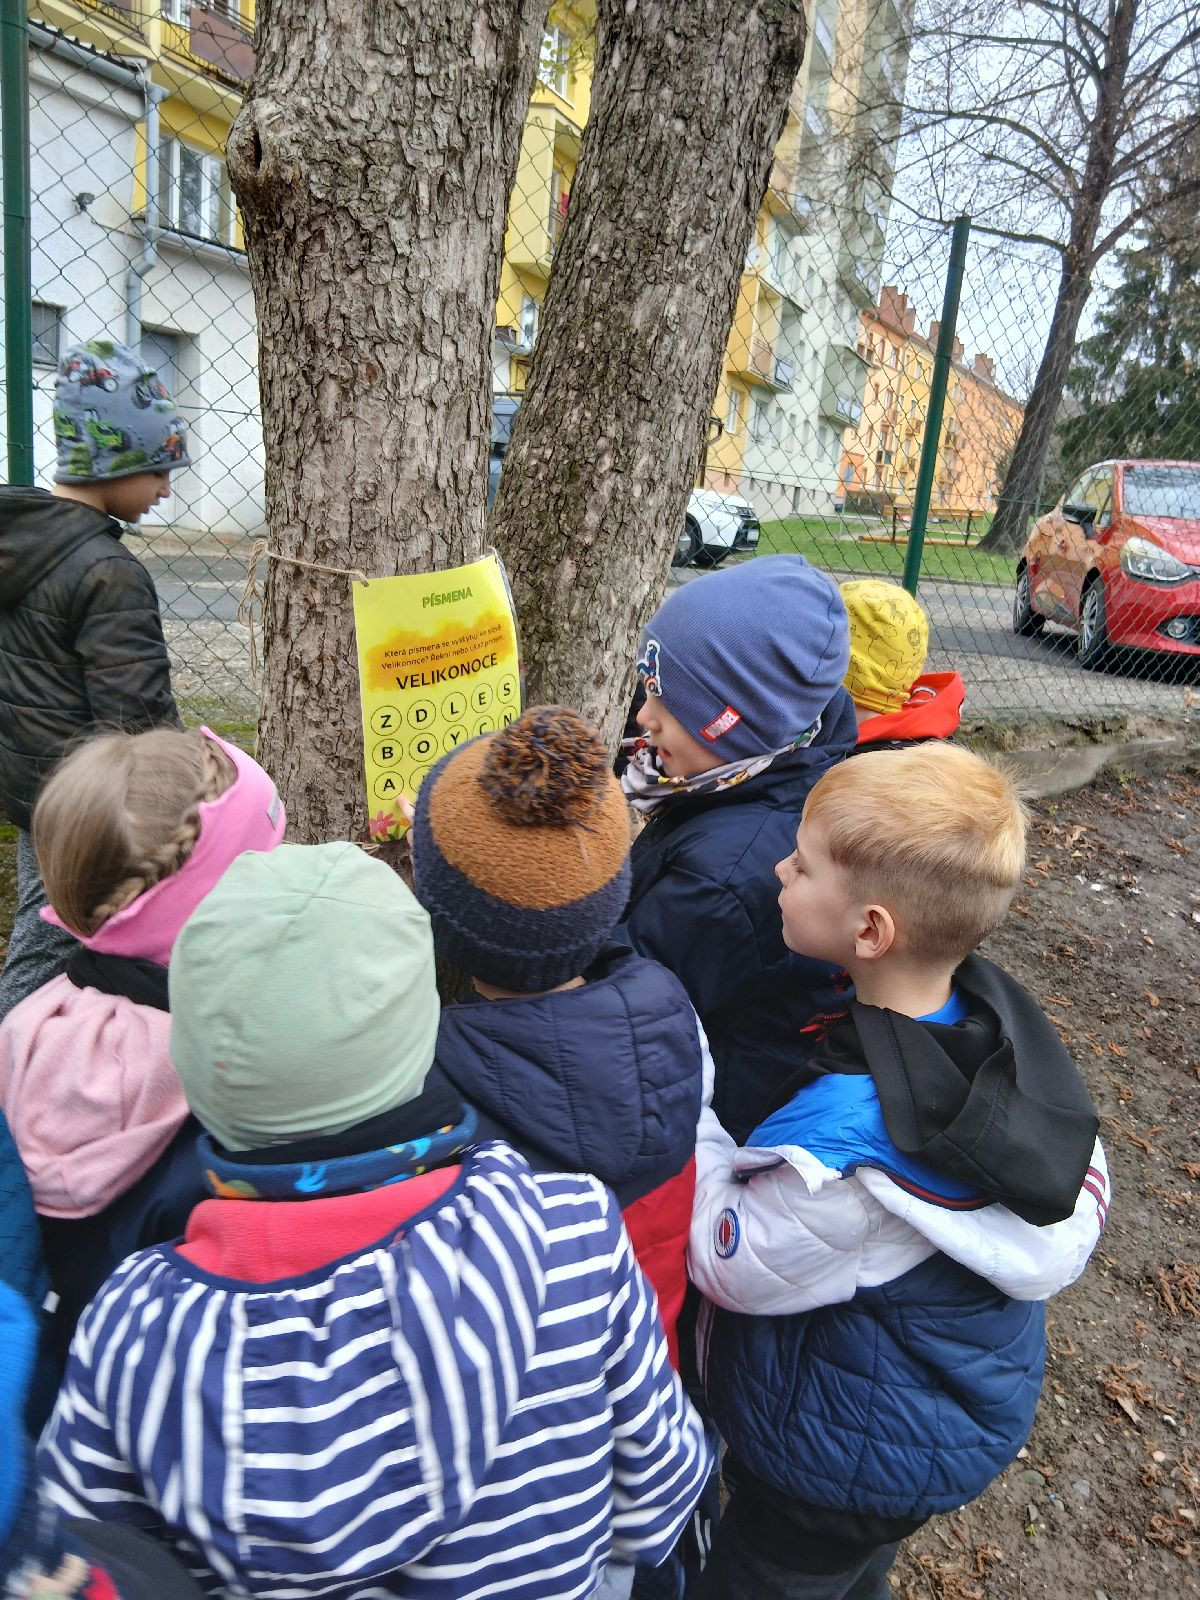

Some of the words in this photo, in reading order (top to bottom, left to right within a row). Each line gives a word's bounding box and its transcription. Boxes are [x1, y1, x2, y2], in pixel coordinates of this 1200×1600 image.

[422, 586, 473, 608] PÍSMENA
[381, 655, 429, 669] Velikonoce?
[430, 651, 451, 661] Řekni
[452, 647, 469, 657] nebo
[384, 648, 407, 658] Která
[408, 643, 440, 656] písmena
[396, 652, 498, 690] VELIKONOCE
[380, 714, 392, 729] Z
[415, 708, 428, 723] D
[450, 702, 460, 715] L
[478, 692, 486, 706] E
[503, 682, 511, 697] S
[381, 746, 394, 760] B
[416, 740, 430, 754] O
[450, 731, 461, 746] Y
[503, 713, 512, 727] N
[383, 778, 395, 792] A
